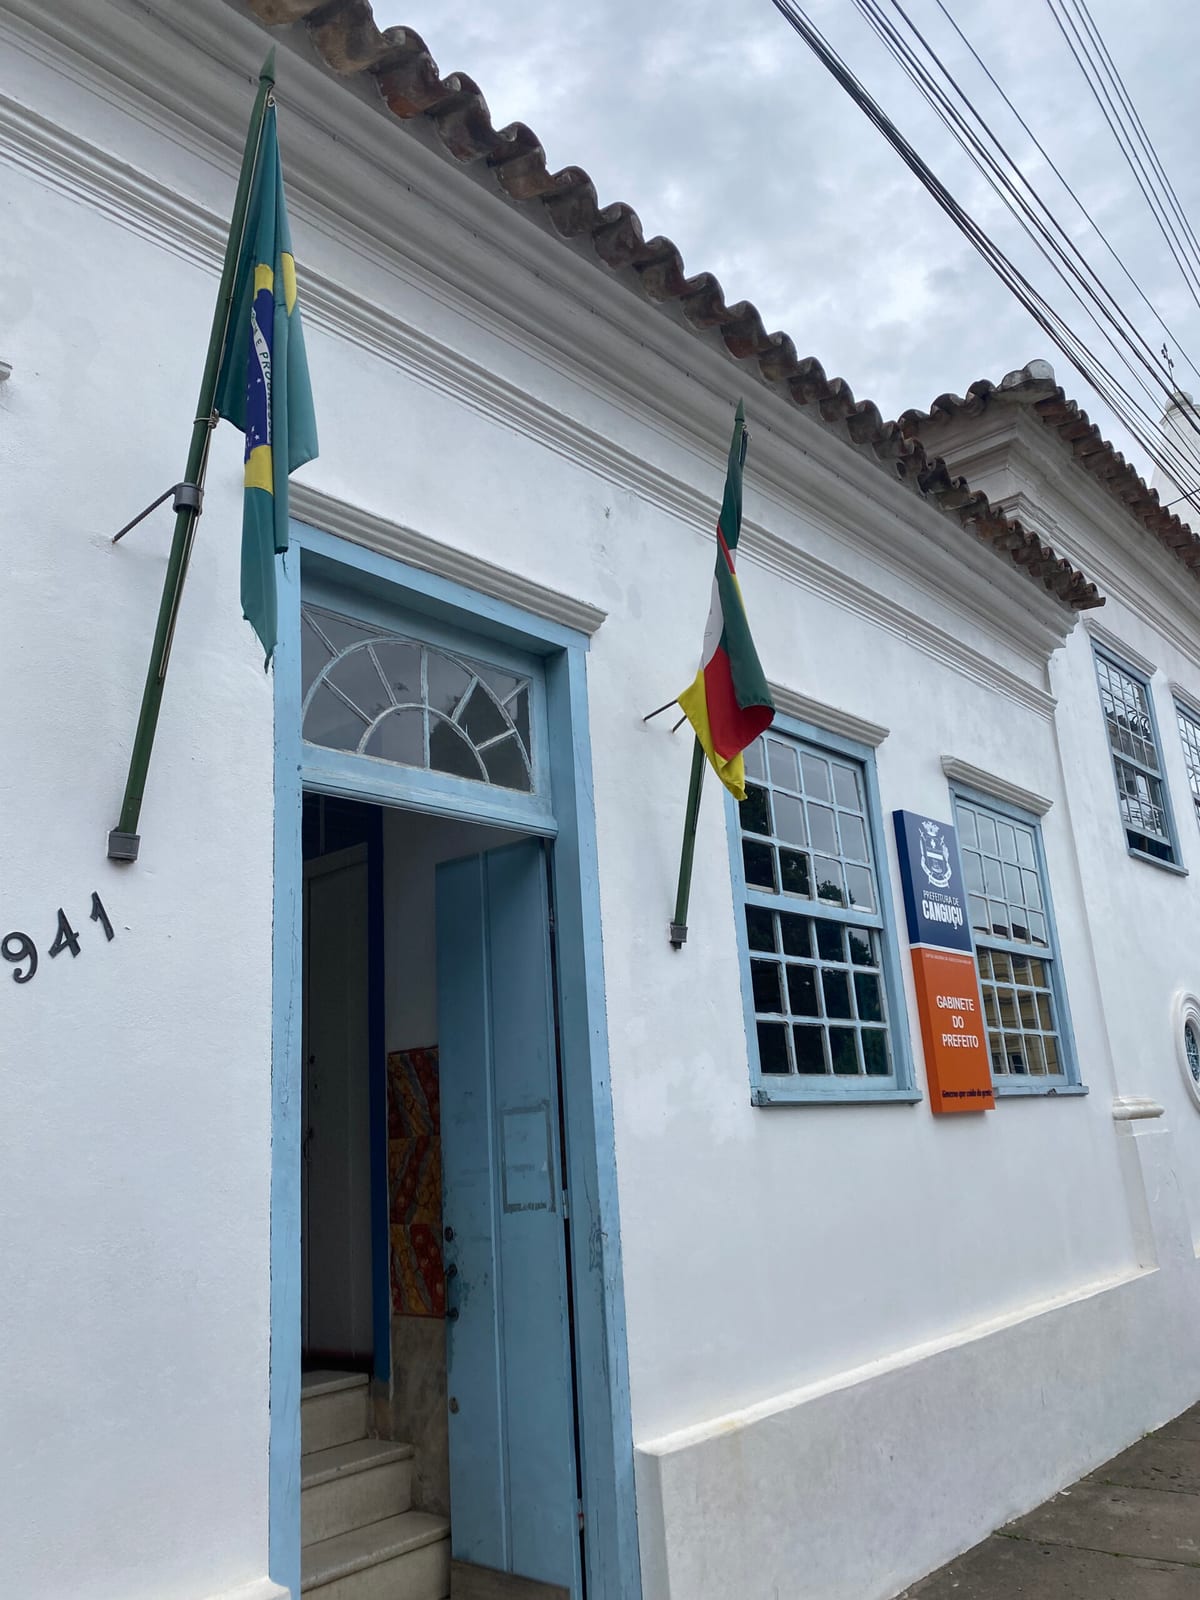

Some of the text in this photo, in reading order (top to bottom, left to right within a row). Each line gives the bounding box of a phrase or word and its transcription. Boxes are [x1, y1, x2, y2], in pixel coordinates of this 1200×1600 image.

[922, 889, 961, 907] PREFEITURA DE
[922, 899, 964, 930] CANGUÇU
[1, 890, 115, 984] 941
[936, 995, 975, 1012] GABINETE
[952, 1015, 965, 1029] DO
[942, 1033, 979, 1048] PREFEITO
